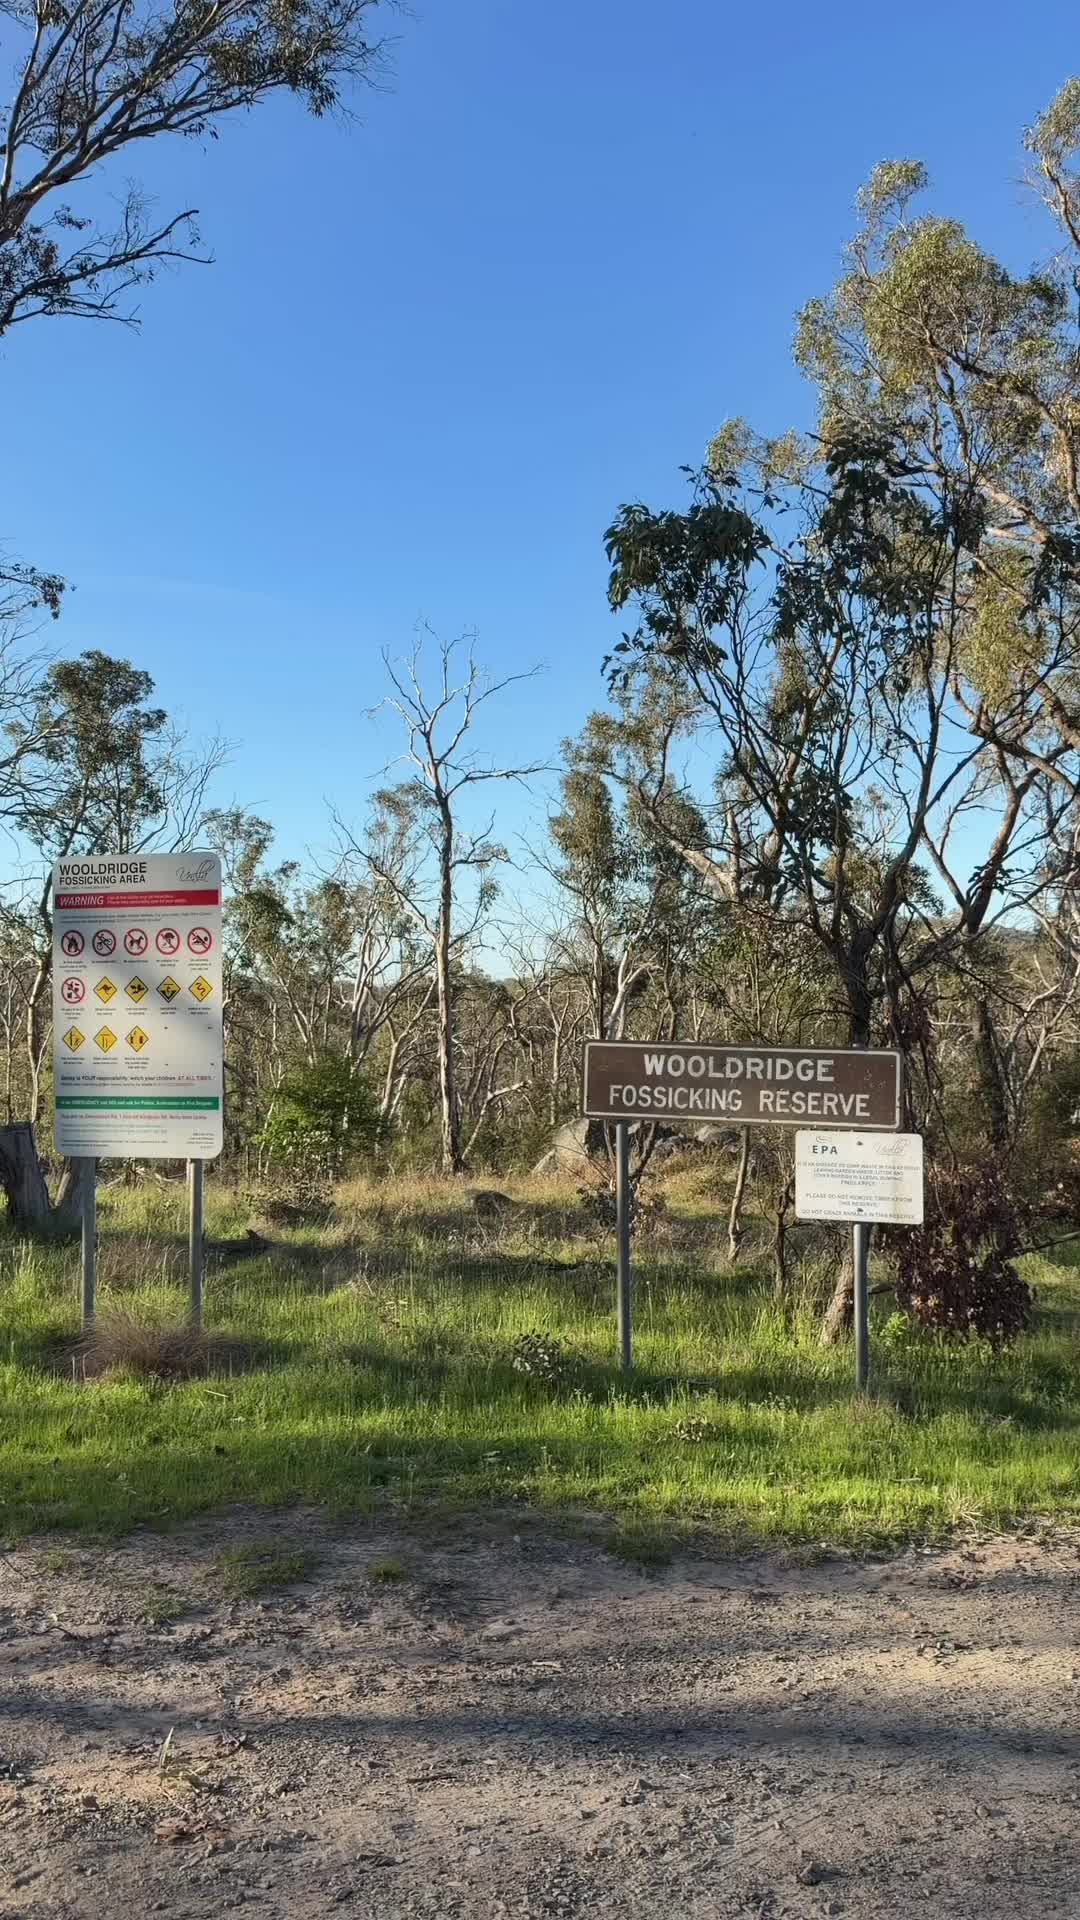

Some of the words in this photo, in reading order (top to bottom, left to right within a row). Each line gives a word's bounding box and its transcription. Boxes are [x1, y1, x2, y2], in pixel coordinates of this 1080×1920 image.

[59, 862, 147, 876] WOOLDRIDGE
[59, 876, 117, 886] FOSSICKING
[119, 874, 146, 884] AREA
[60, 895, 105, 907] WARNING
[643, 1053, 835, 1082] WOOLDRIDGE
[608, 1084, 743, 1112] FOSSICKING
[759, 1089, 871, 1117] RESERVE
[812, 1145, 838, 1155] EPA
